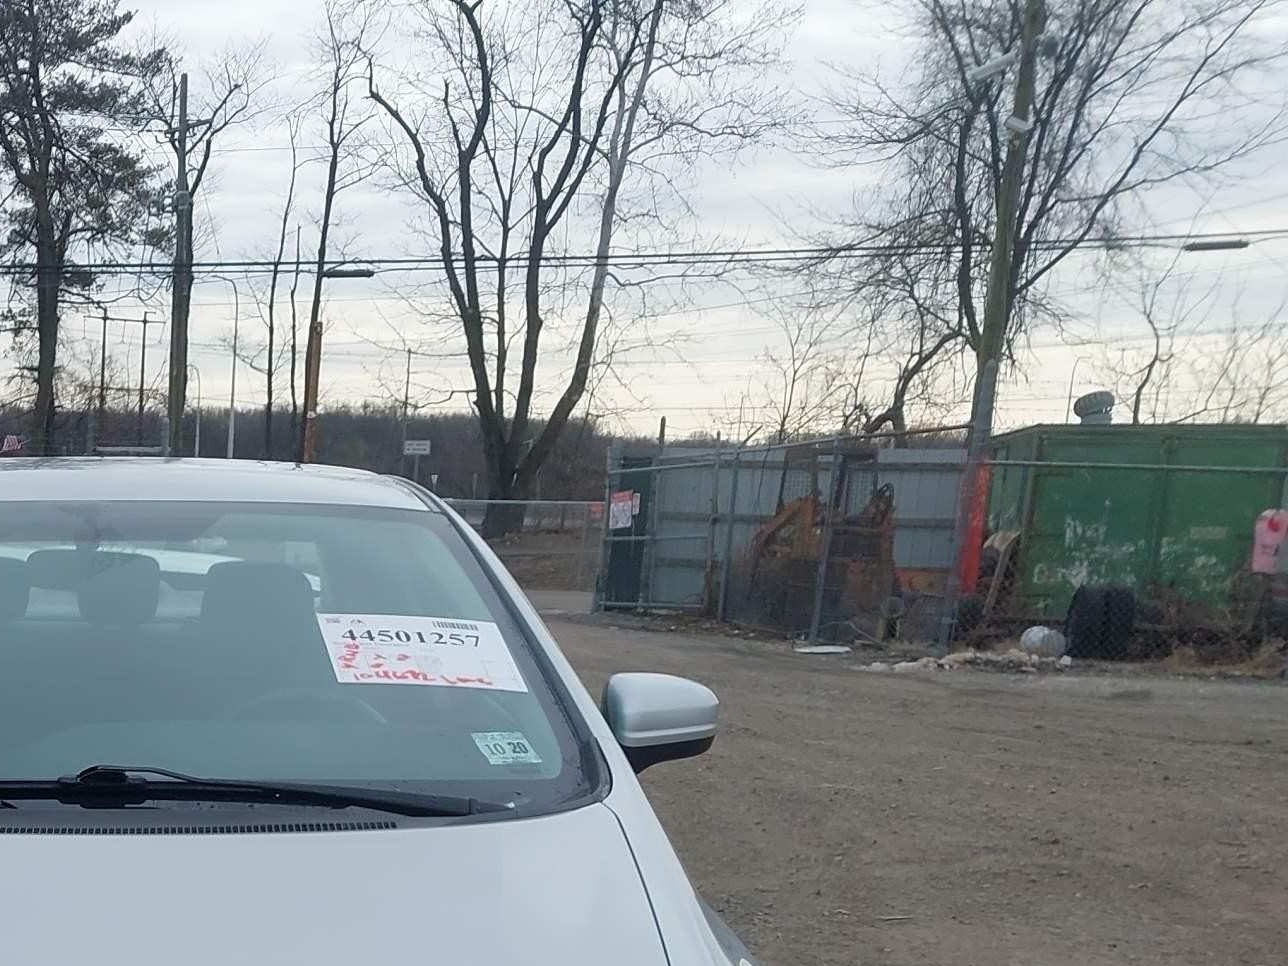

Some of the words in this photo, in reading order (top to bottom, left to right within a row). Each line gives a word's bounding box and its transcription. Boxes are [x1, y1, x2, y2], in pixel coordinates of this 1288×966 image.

[341, 629, 479, 648] 44501257
[485, 742, 506, 755] 10
[507, 741, 529, 754] 20
